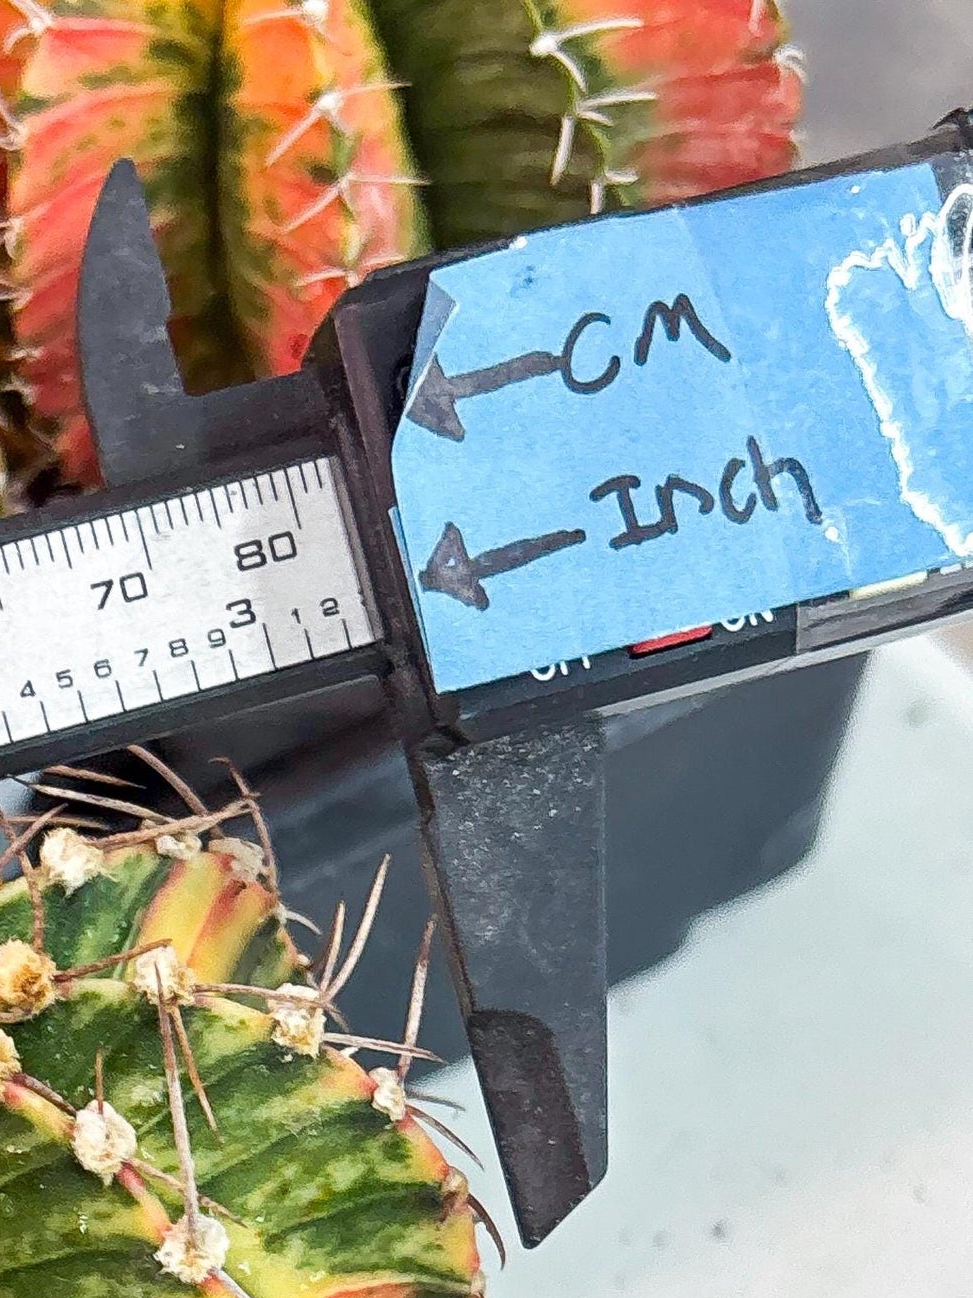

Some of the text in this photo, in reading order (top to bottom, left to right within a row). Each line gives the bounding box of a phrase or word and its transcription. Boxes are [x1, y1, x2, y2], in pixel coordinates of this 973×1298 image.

[588, 434, 823, 552] Inch
[90, 572, 149, 610] 70
[234, 530, 298, 572] 80
[19, 679, 37, 699] 4
[55, 669, 74, 689] 5
[93, 659, 113, 679] 6
[134, 648, 150, 667] 7
[168, 638, 189, 658] 8
[207, 628, 227, 649] 9
[225, 598, 257, 629] 3
[290, 607, 301, 625] 1
[319, 597, 340, 618] 2
